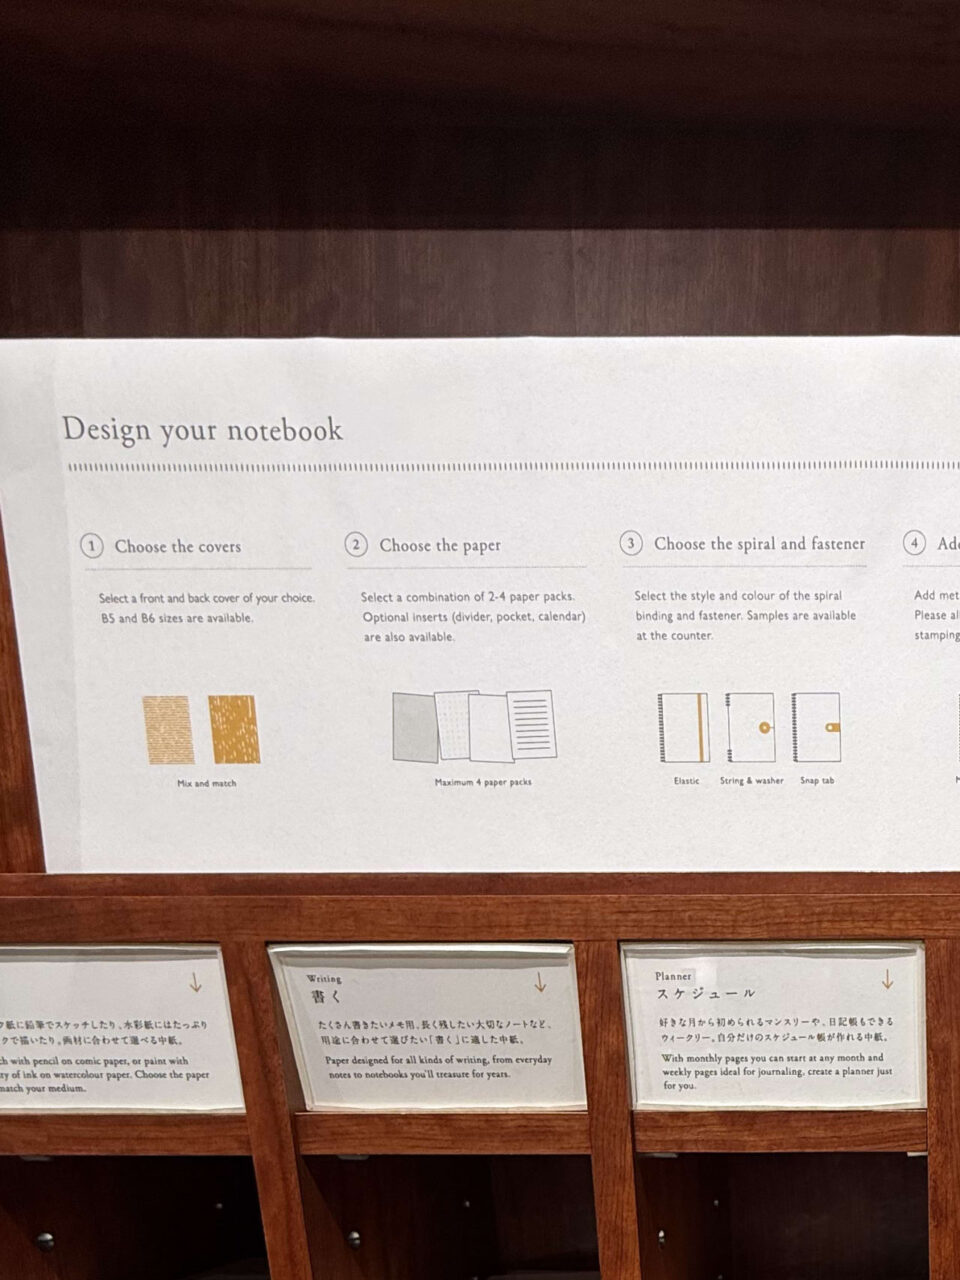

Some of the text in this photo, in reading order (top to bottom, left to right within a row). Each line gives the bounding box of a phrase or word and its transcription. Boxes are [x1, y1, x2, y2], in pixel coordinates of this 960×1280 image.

[61, 415, 344, 449] Design your notebook
[114, 538, 167, 554] Choose
[171, 538, 194, 554] the
[198, 543, 242, 553] covers
[379, 537, 431, 552] Choose
[435, 536, 458, 552] the
[462, 541, 501, 556] paper
[654, 535, 706, 550] Choose
[710, 535, 733, 550] the
[737, 535, 776, 555] spiral
[780, 535, 806, 550] and
[811, 535, 866, 550] fastener
[176, 778, 237, 788] Mix and match
[434, 777, 532, 788] Maximum 4 paper packs
[673, 776, 700, 785] Elastic
[719, 776, 784, 787] String & washer
[800, 776, 835, 787] Snap tab
[305, 974, 342, 985] Writing
[654, 971, 691, 981] Planner
[310, 989, 340, 1004] 書く
[657, 986, 755, 1000] スケジュール
[364, 1069, 408, 1079] notebooks
[471, 1068, 484, 1078] for
[486, 1071, 511, 1081] years.
